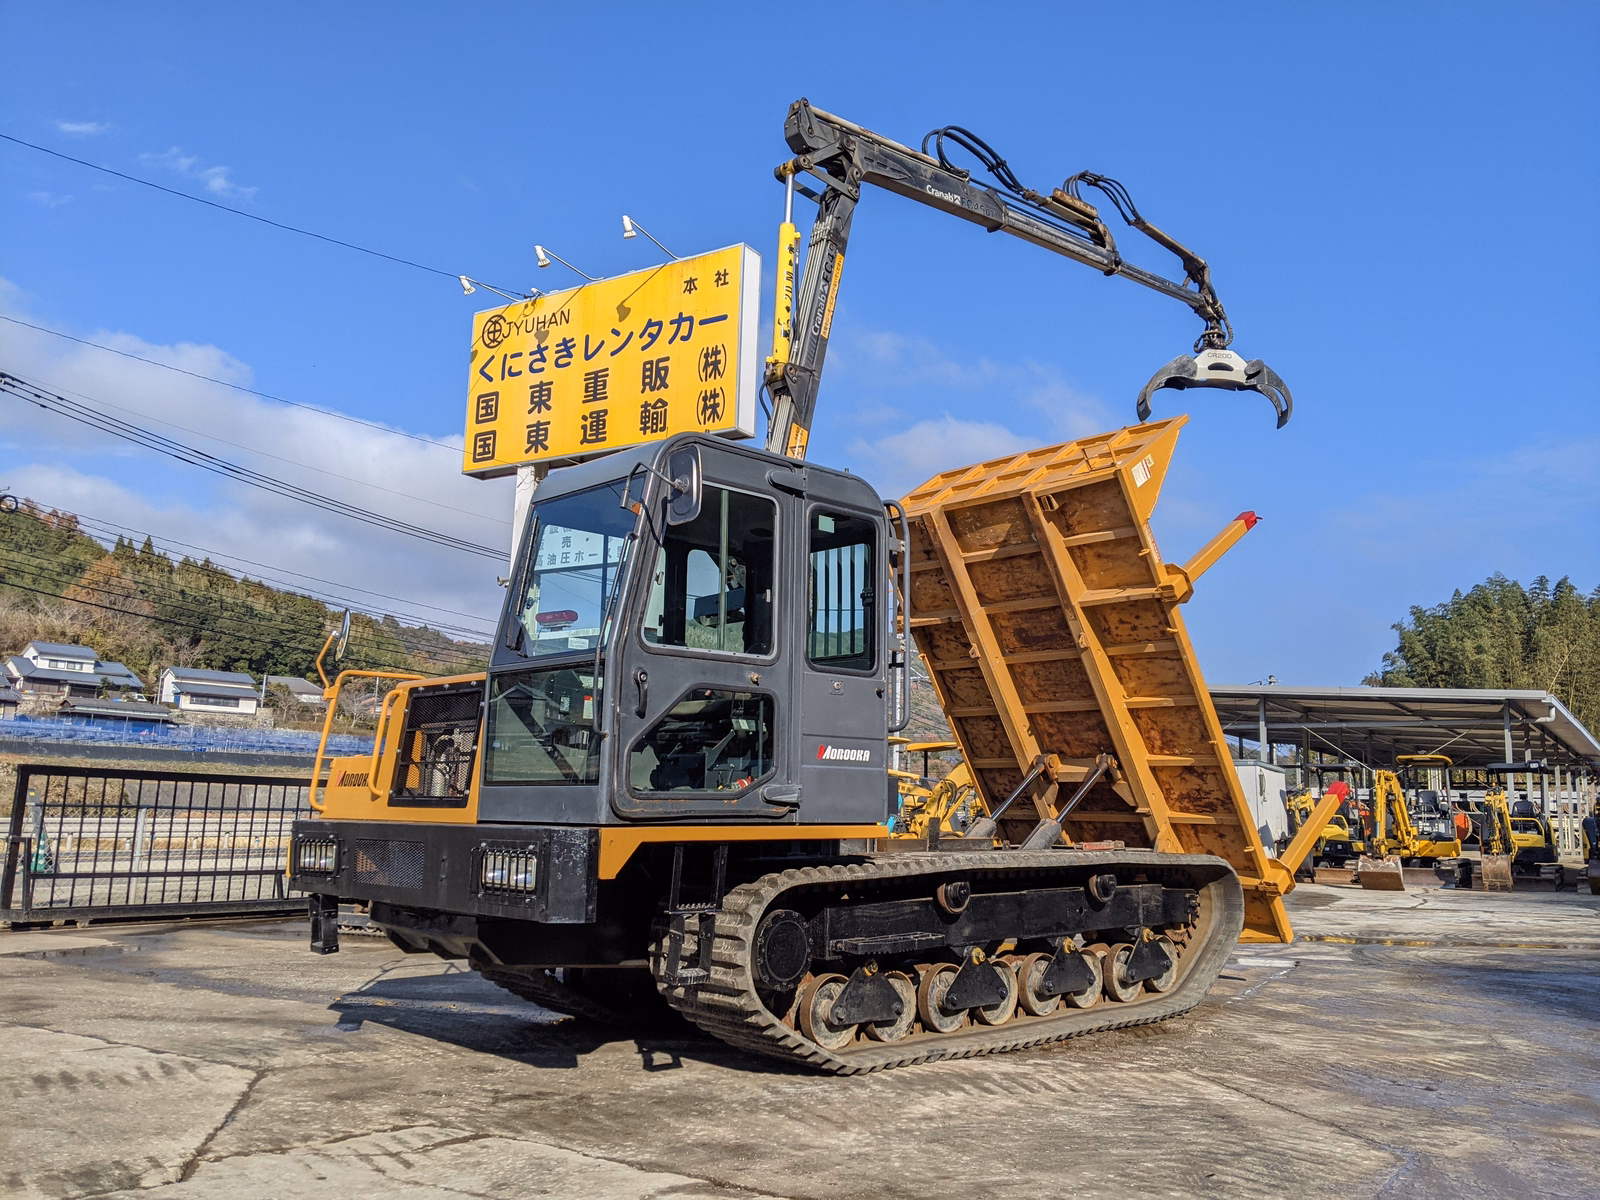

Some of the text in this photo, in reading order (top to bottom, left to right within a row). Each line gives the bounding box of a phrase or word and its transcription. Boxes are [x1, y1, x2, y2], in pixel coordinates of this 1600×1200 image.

[926, 184, 953, 202] Cranab
[682, 268, 729, 295] 本社
[502, 308, 571, 339] JYUHAN
[811, 293, 827, 336] Cranab
[478, 311, 728, 383] くにさきレンタカー
[1207, 352, 1233, 360] CR200
[816, 744, 871, 762] MOROOKA
[334, 769, 370, 788] MOROOK
